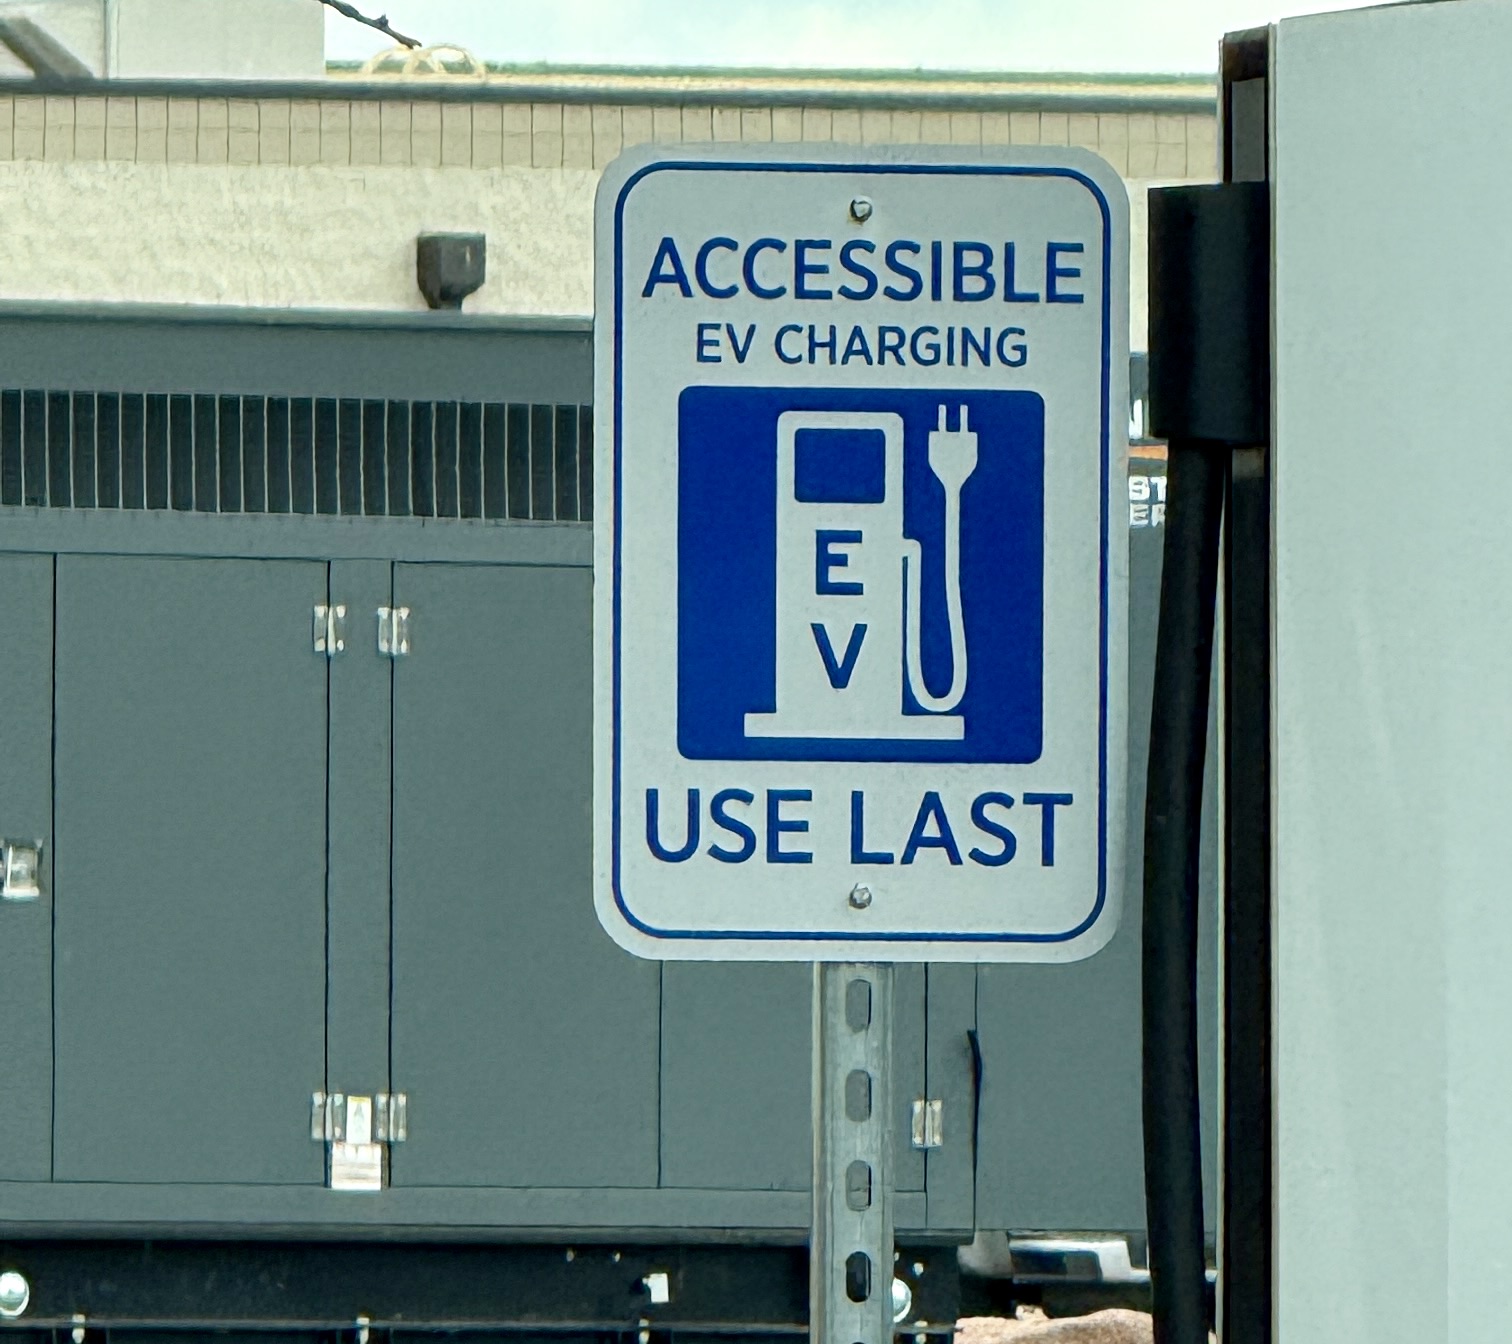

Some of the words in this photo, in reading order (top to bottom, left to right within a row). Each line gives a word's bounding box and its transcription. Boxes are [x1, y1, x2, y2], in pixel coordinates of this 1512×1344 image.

[640, 235, 1086, 306] ACCESSIBLE
[695, 321, 758, 365] EV
[773, 322, 1030, 369] CHARGING
[644, 786, 815, 865] USE
[849, 789, 1075, 869] LAST
